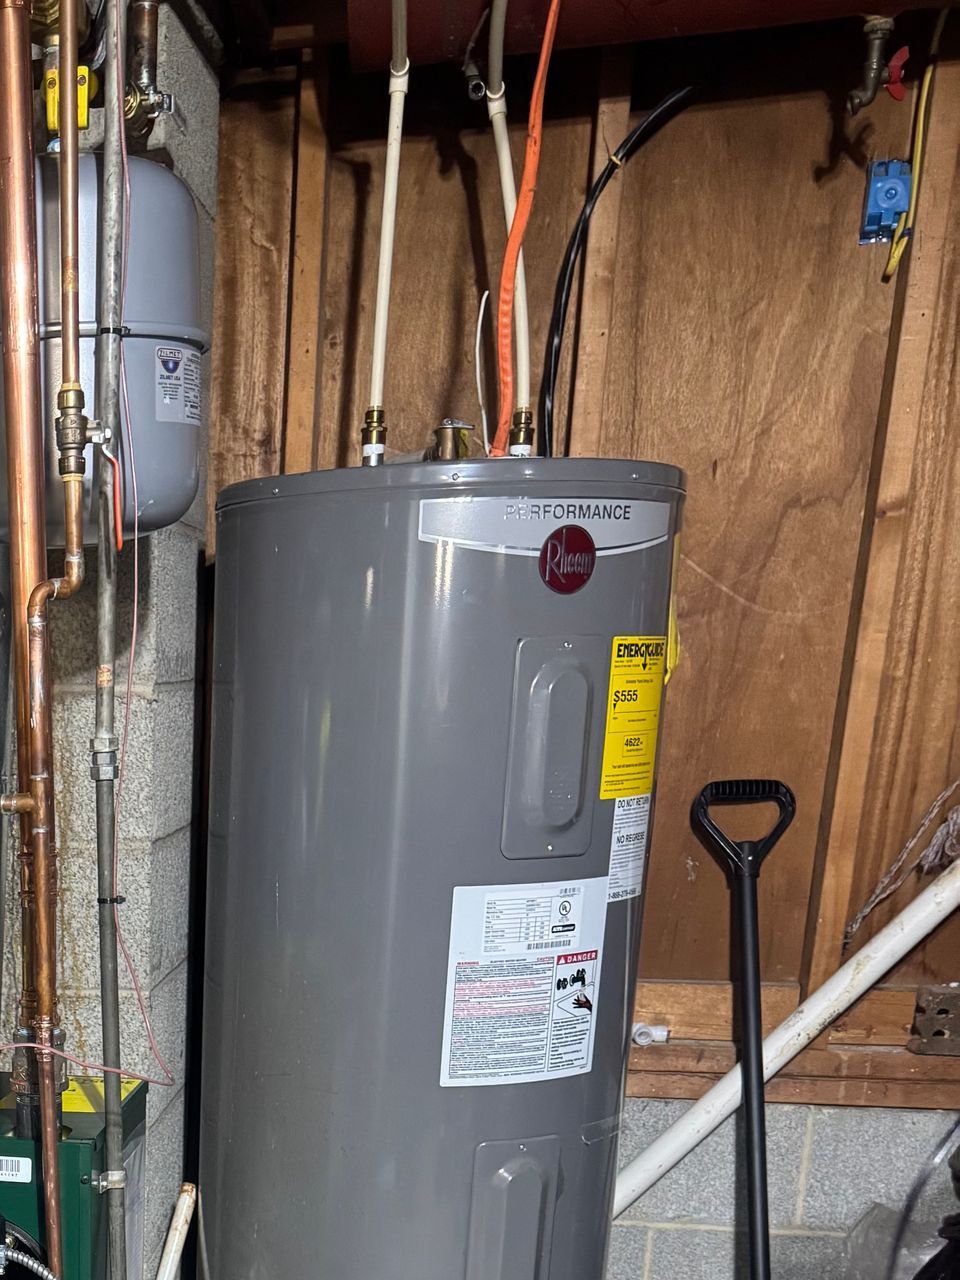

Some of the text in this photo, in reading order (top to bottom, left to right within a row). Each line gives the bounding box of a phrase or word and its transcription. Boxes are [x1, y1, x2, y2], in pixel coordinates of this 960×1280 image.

[504, 503, 632, 520] PERFORMANCE
[545, 529, 590, 583] Rheem
[613, 690, 638, 703] $555
[567, 952, 596, 963] DANGER
